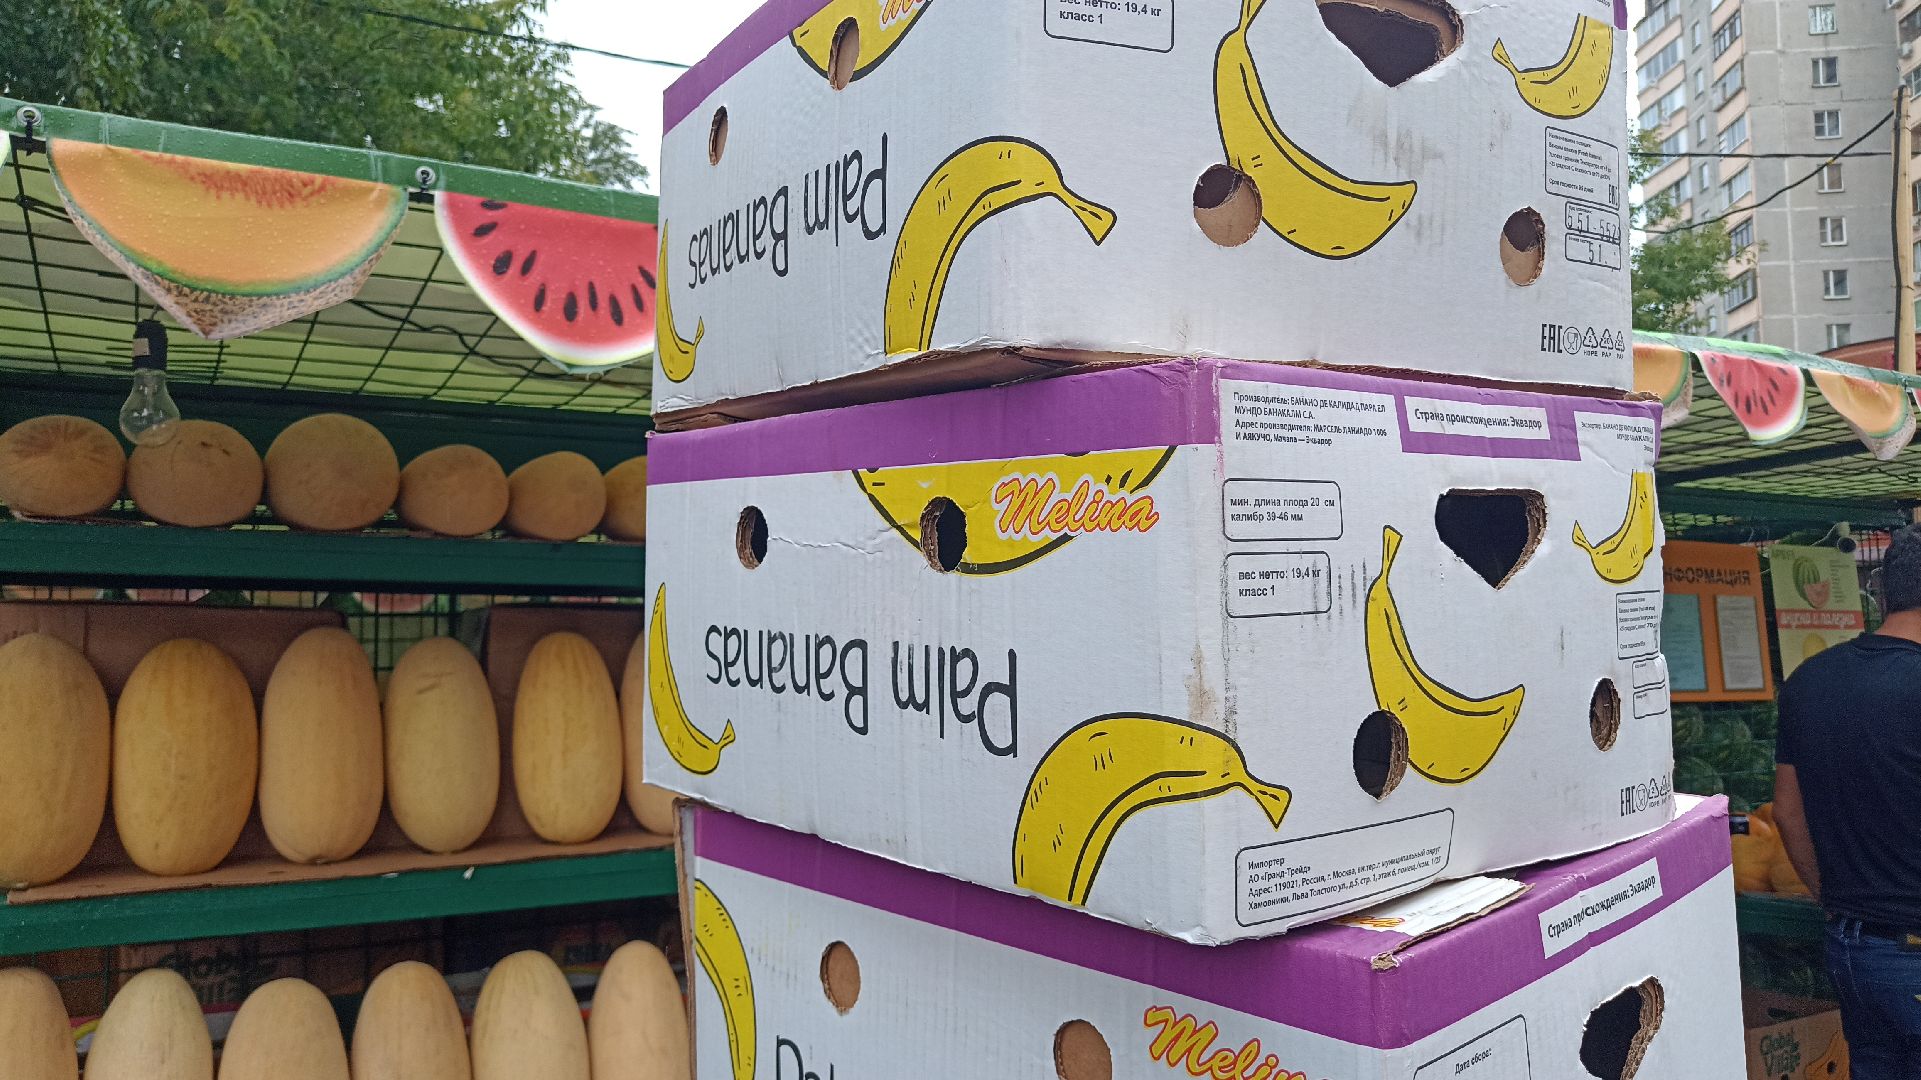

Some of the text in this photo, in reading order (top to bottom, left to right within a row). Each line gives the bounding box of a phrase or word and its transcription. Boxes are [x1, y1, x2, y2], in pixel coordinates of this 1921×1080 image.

[1059, 10, 1103, 24] класс 1
[1125, 2, 1148, 15] 19,4
[1151, 7, 1162, 17] кг
[688, 132, 888, 289] Palm Bananas
[1540, 323, 1563, 353] EAC
[1233, 391, 1290, 405] Производитель:
[1291, 396, 1319, 408] БАНАНО
[1235, 419, 1259, 429] Адрес
[1259, 422, 1313, 433] производителя:
[1414, 408, 1542, 430] Страна происхождения: Эквадор
[995, 477, 1160, 536] Melina
[1230, 497, 1335, 509] мин. длина плода 20 см
[1230, 511, 1304, 523] калибр 39-46 мм
[1238, 566, 1322, 580] вес нетто: 19,4 кг
[1664, 566, 1751, 587] НФОРМАЦИЯ
[1238, 584, 1275, 597] класс 1
[704, 624, 1018, 759] Palm Bananas
[1620, 786, 1636, 817] EAC
[1248, 857, 1285, 870] Импортер
[1248, 865, 1311, 884] АО «Гранд-Трейд»
[1248, 885, 1273, 898] Адрес:
[1274, 880, 1301, 892] 119021,
[1301, 875, 1326, 887] Россия,
[1332, 868, 1357, 879] Москва,
[1248, 896, 1291, 911] Хамовники,
[1291, 891, 1309, 902] Льва
[1309, 885, 1337, 897] Толстого
[1547, 917, 1573, 938] Страна
[1629, 875, 1656, 897] Эквадор
[1454, 1047, 1492, 1076] Дата сбора:
